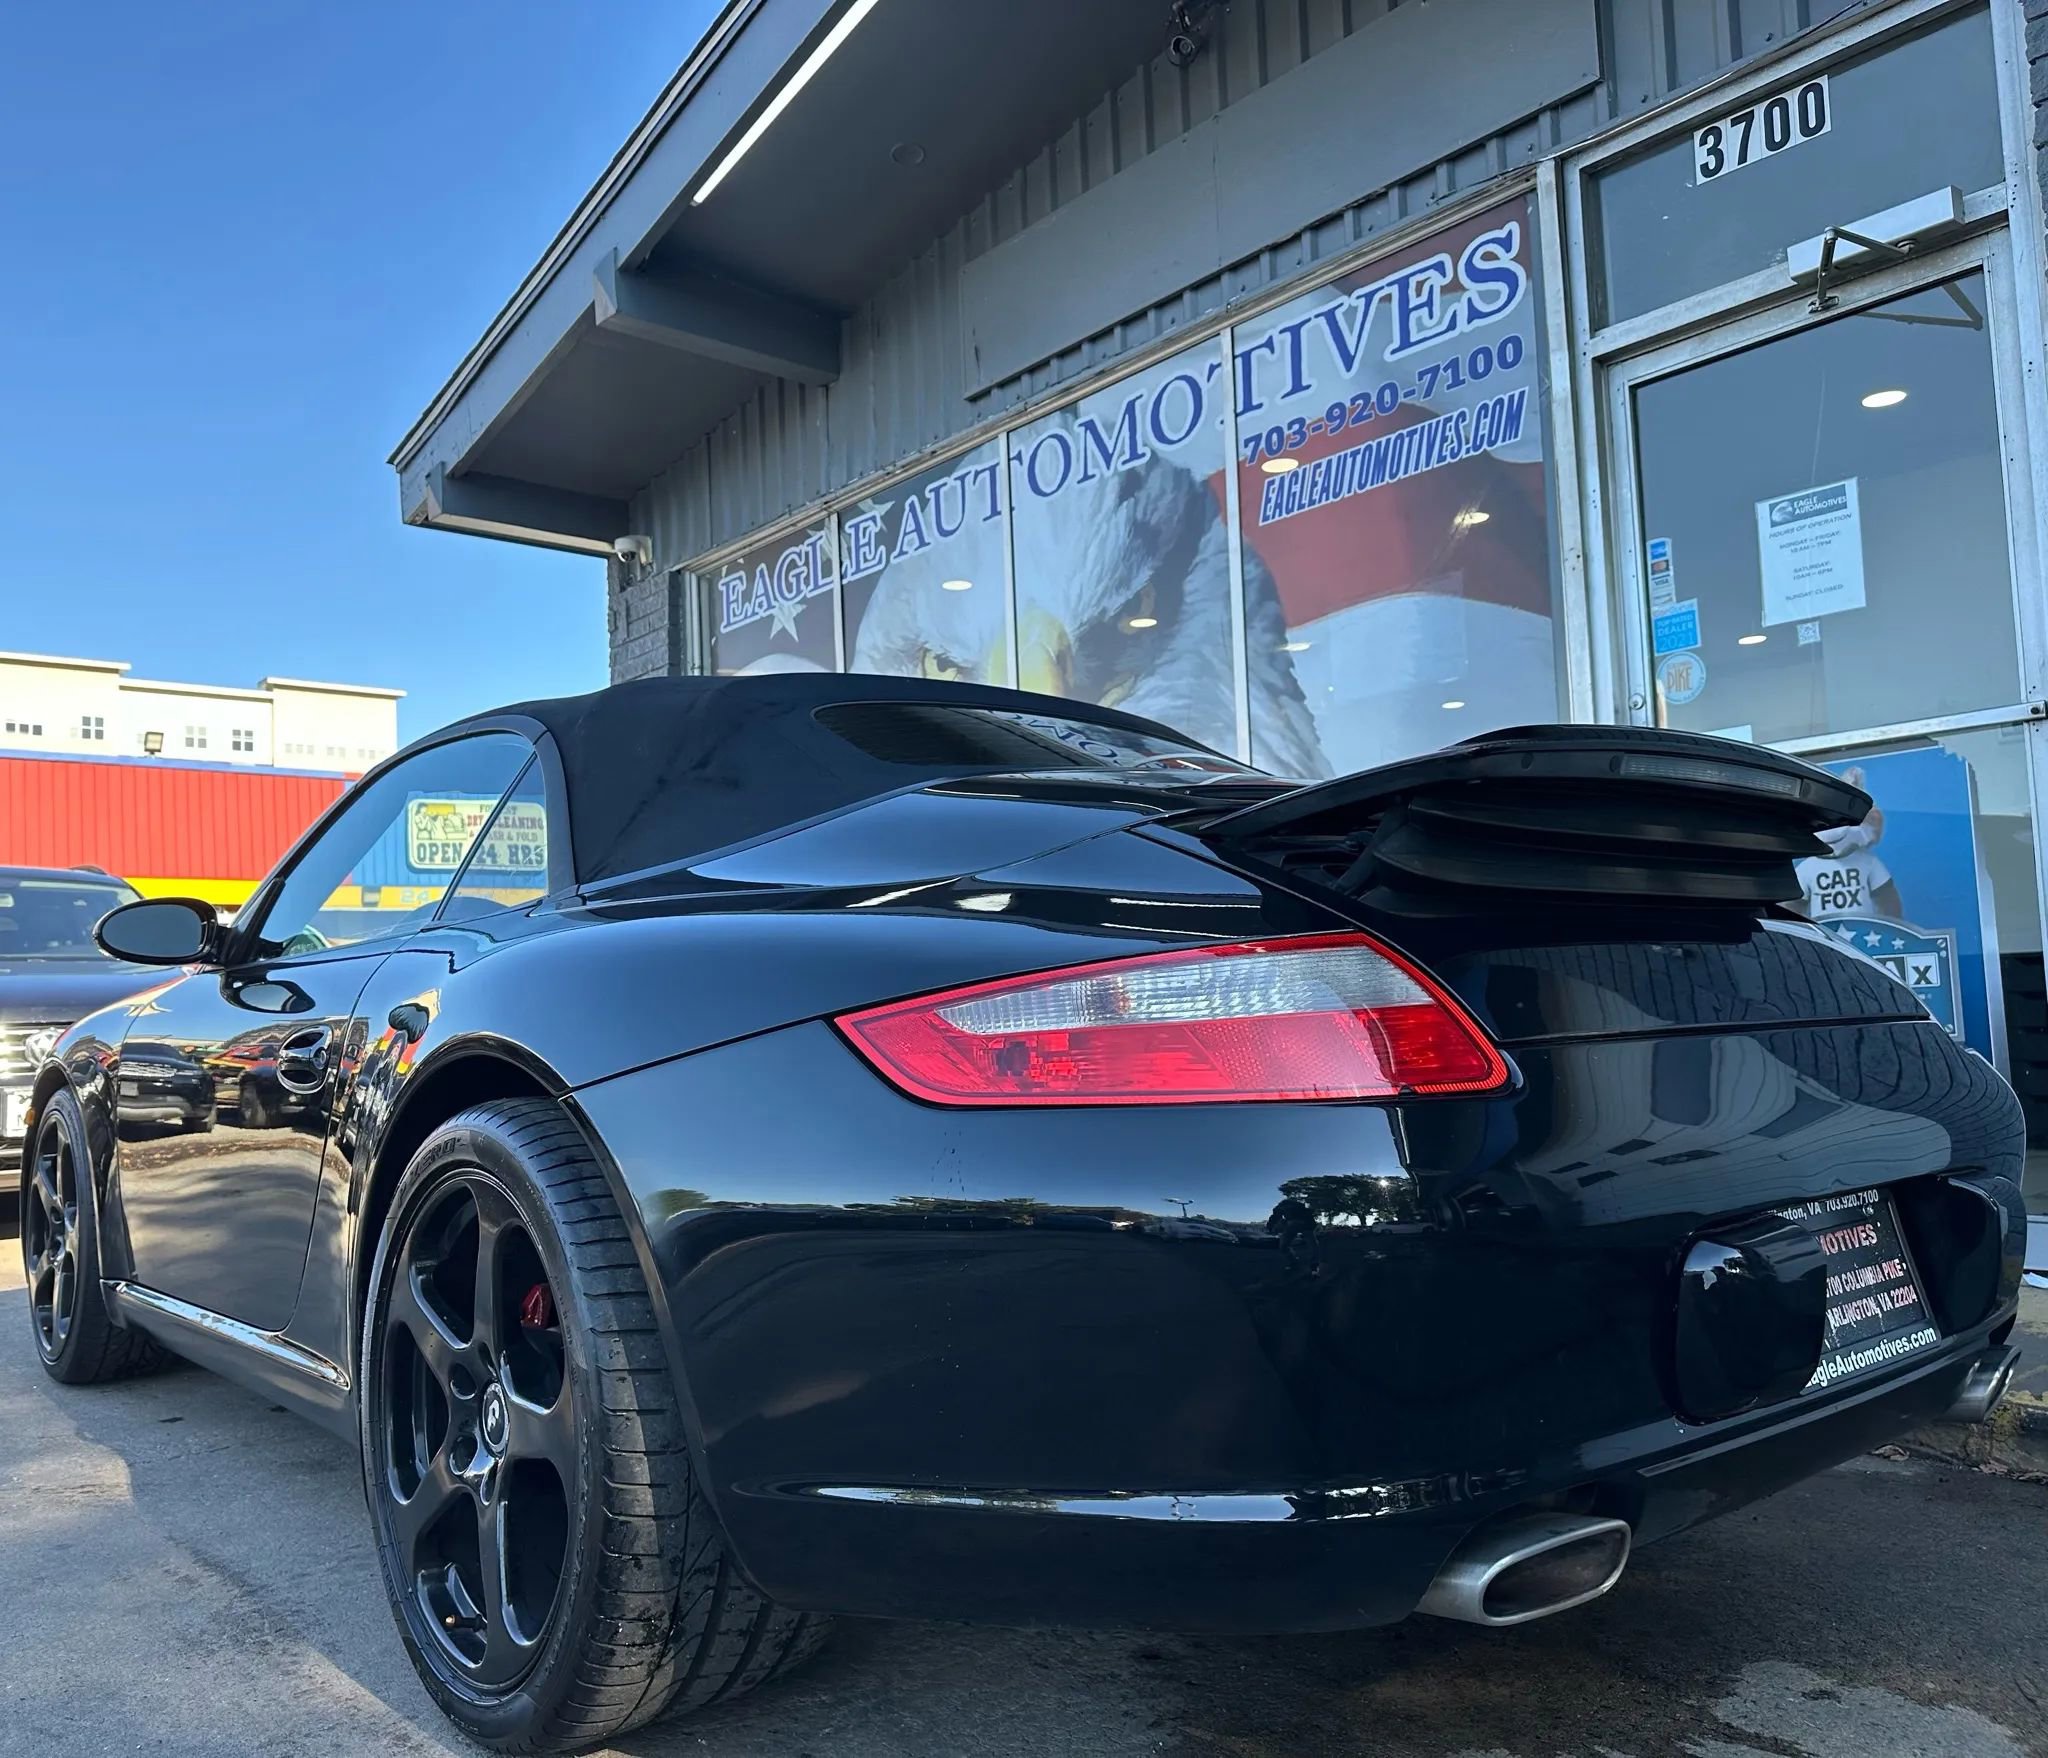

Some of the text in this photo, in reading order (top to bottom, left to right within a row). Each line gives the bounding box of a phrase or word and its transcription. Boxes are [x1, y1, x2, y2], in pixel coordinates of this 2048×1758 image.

[1698, 81, 1826, 178] 3700
[1243, 334, 1524, 467] 703-920-7100
[719, 220, 1526, 634] EAGLE AUTOMOTIVES
[1259, 386, 1529, 526] EAGLEAUTOMOTIVES.COM
[1793, 496, 1818, 508] EAGLE
[1794, 495, 1848, 515] AUTOMOTIVES
[493, 815, 544, 831] LEANING
[416, 843, 463, 865] OPEN
[507, 843, 545, 865] HRS
[1816, 868, 1861, 891] CAR
[1820, 887, 1863, 911] FOX
[1806, 1201, 1823, 1216] VA
[1841, 1264, 1886, 1292] COLUMBIA
[1881, 1258, 1904, 1280] PIKE
[1877, 1291, 1894, 1312] VA
[1890, 1284, 1918, 1308] 22204
[1805, 1326, 1937, 1387] agleAutomotives.com
